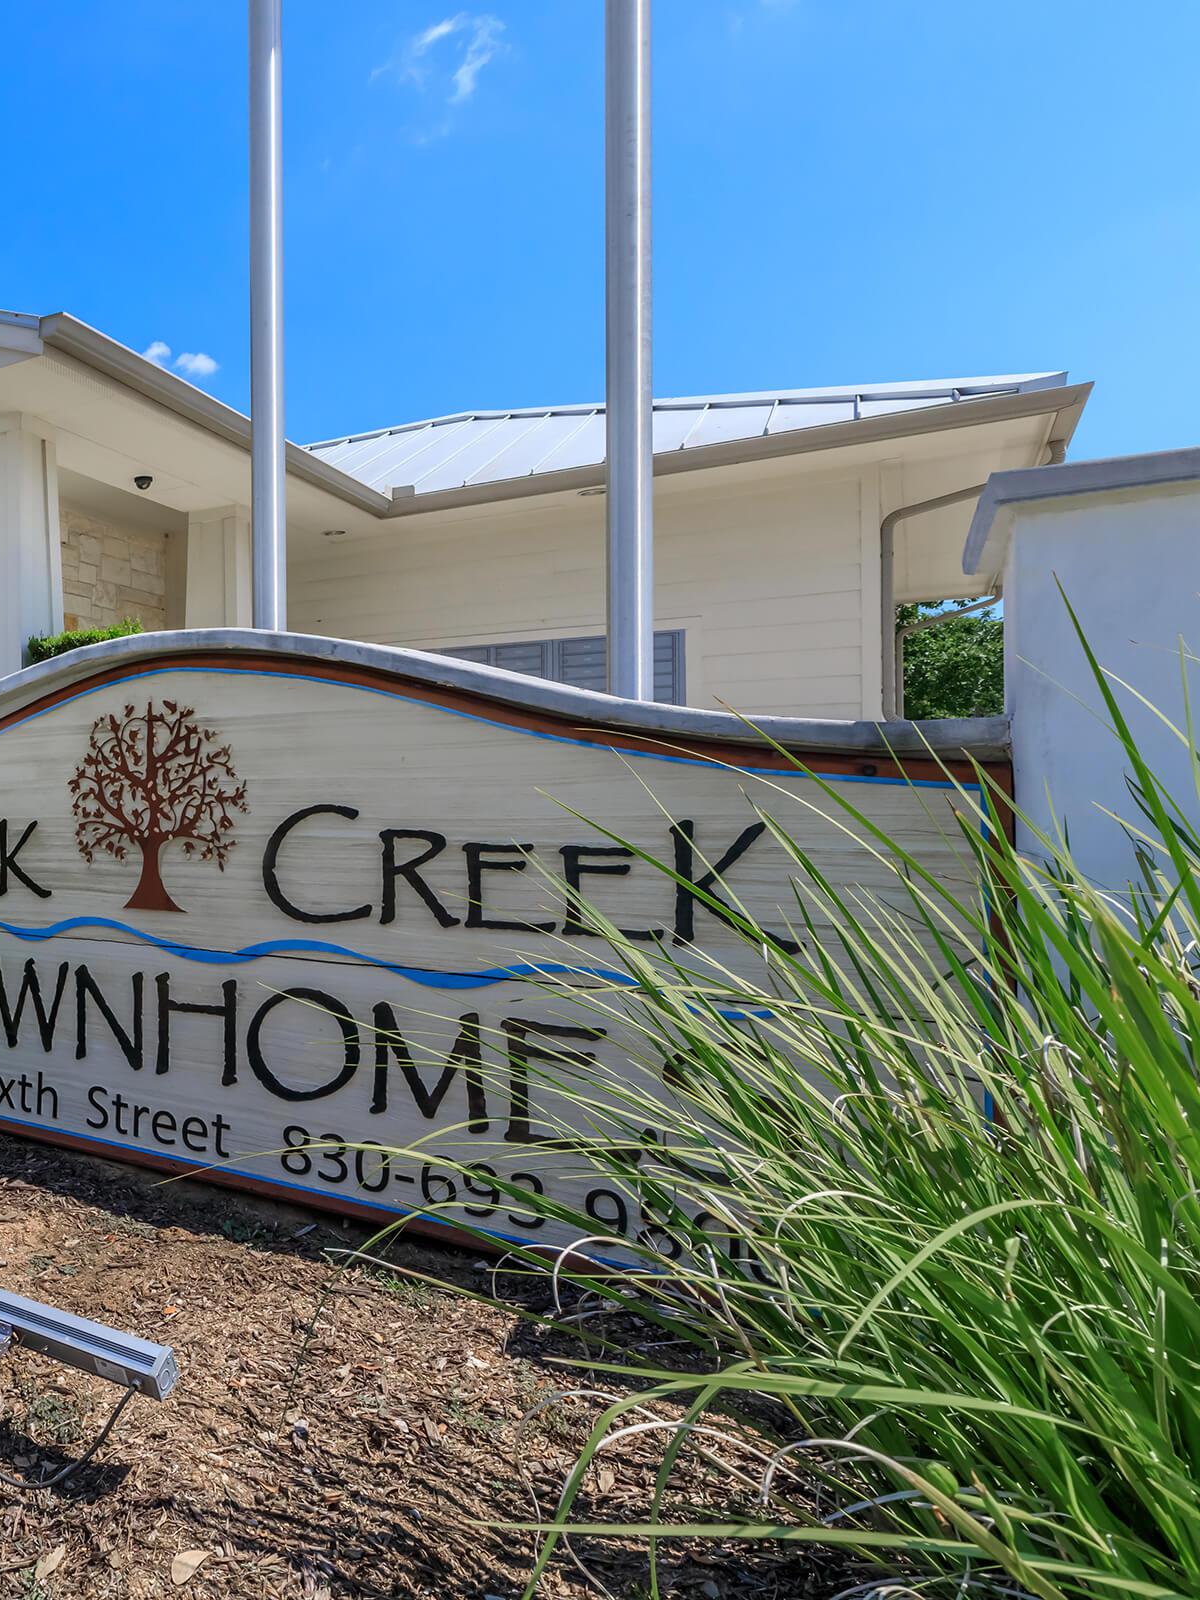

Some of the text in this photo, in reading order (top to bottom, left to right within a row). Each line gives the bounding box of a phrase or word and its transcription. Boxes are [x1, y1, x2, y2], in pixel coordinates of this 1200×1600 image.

[262, 803, 806, 955] CREEK
[86, 1085, 231, 1158] Street
[280, 1125, 547, 1230] 830-693
